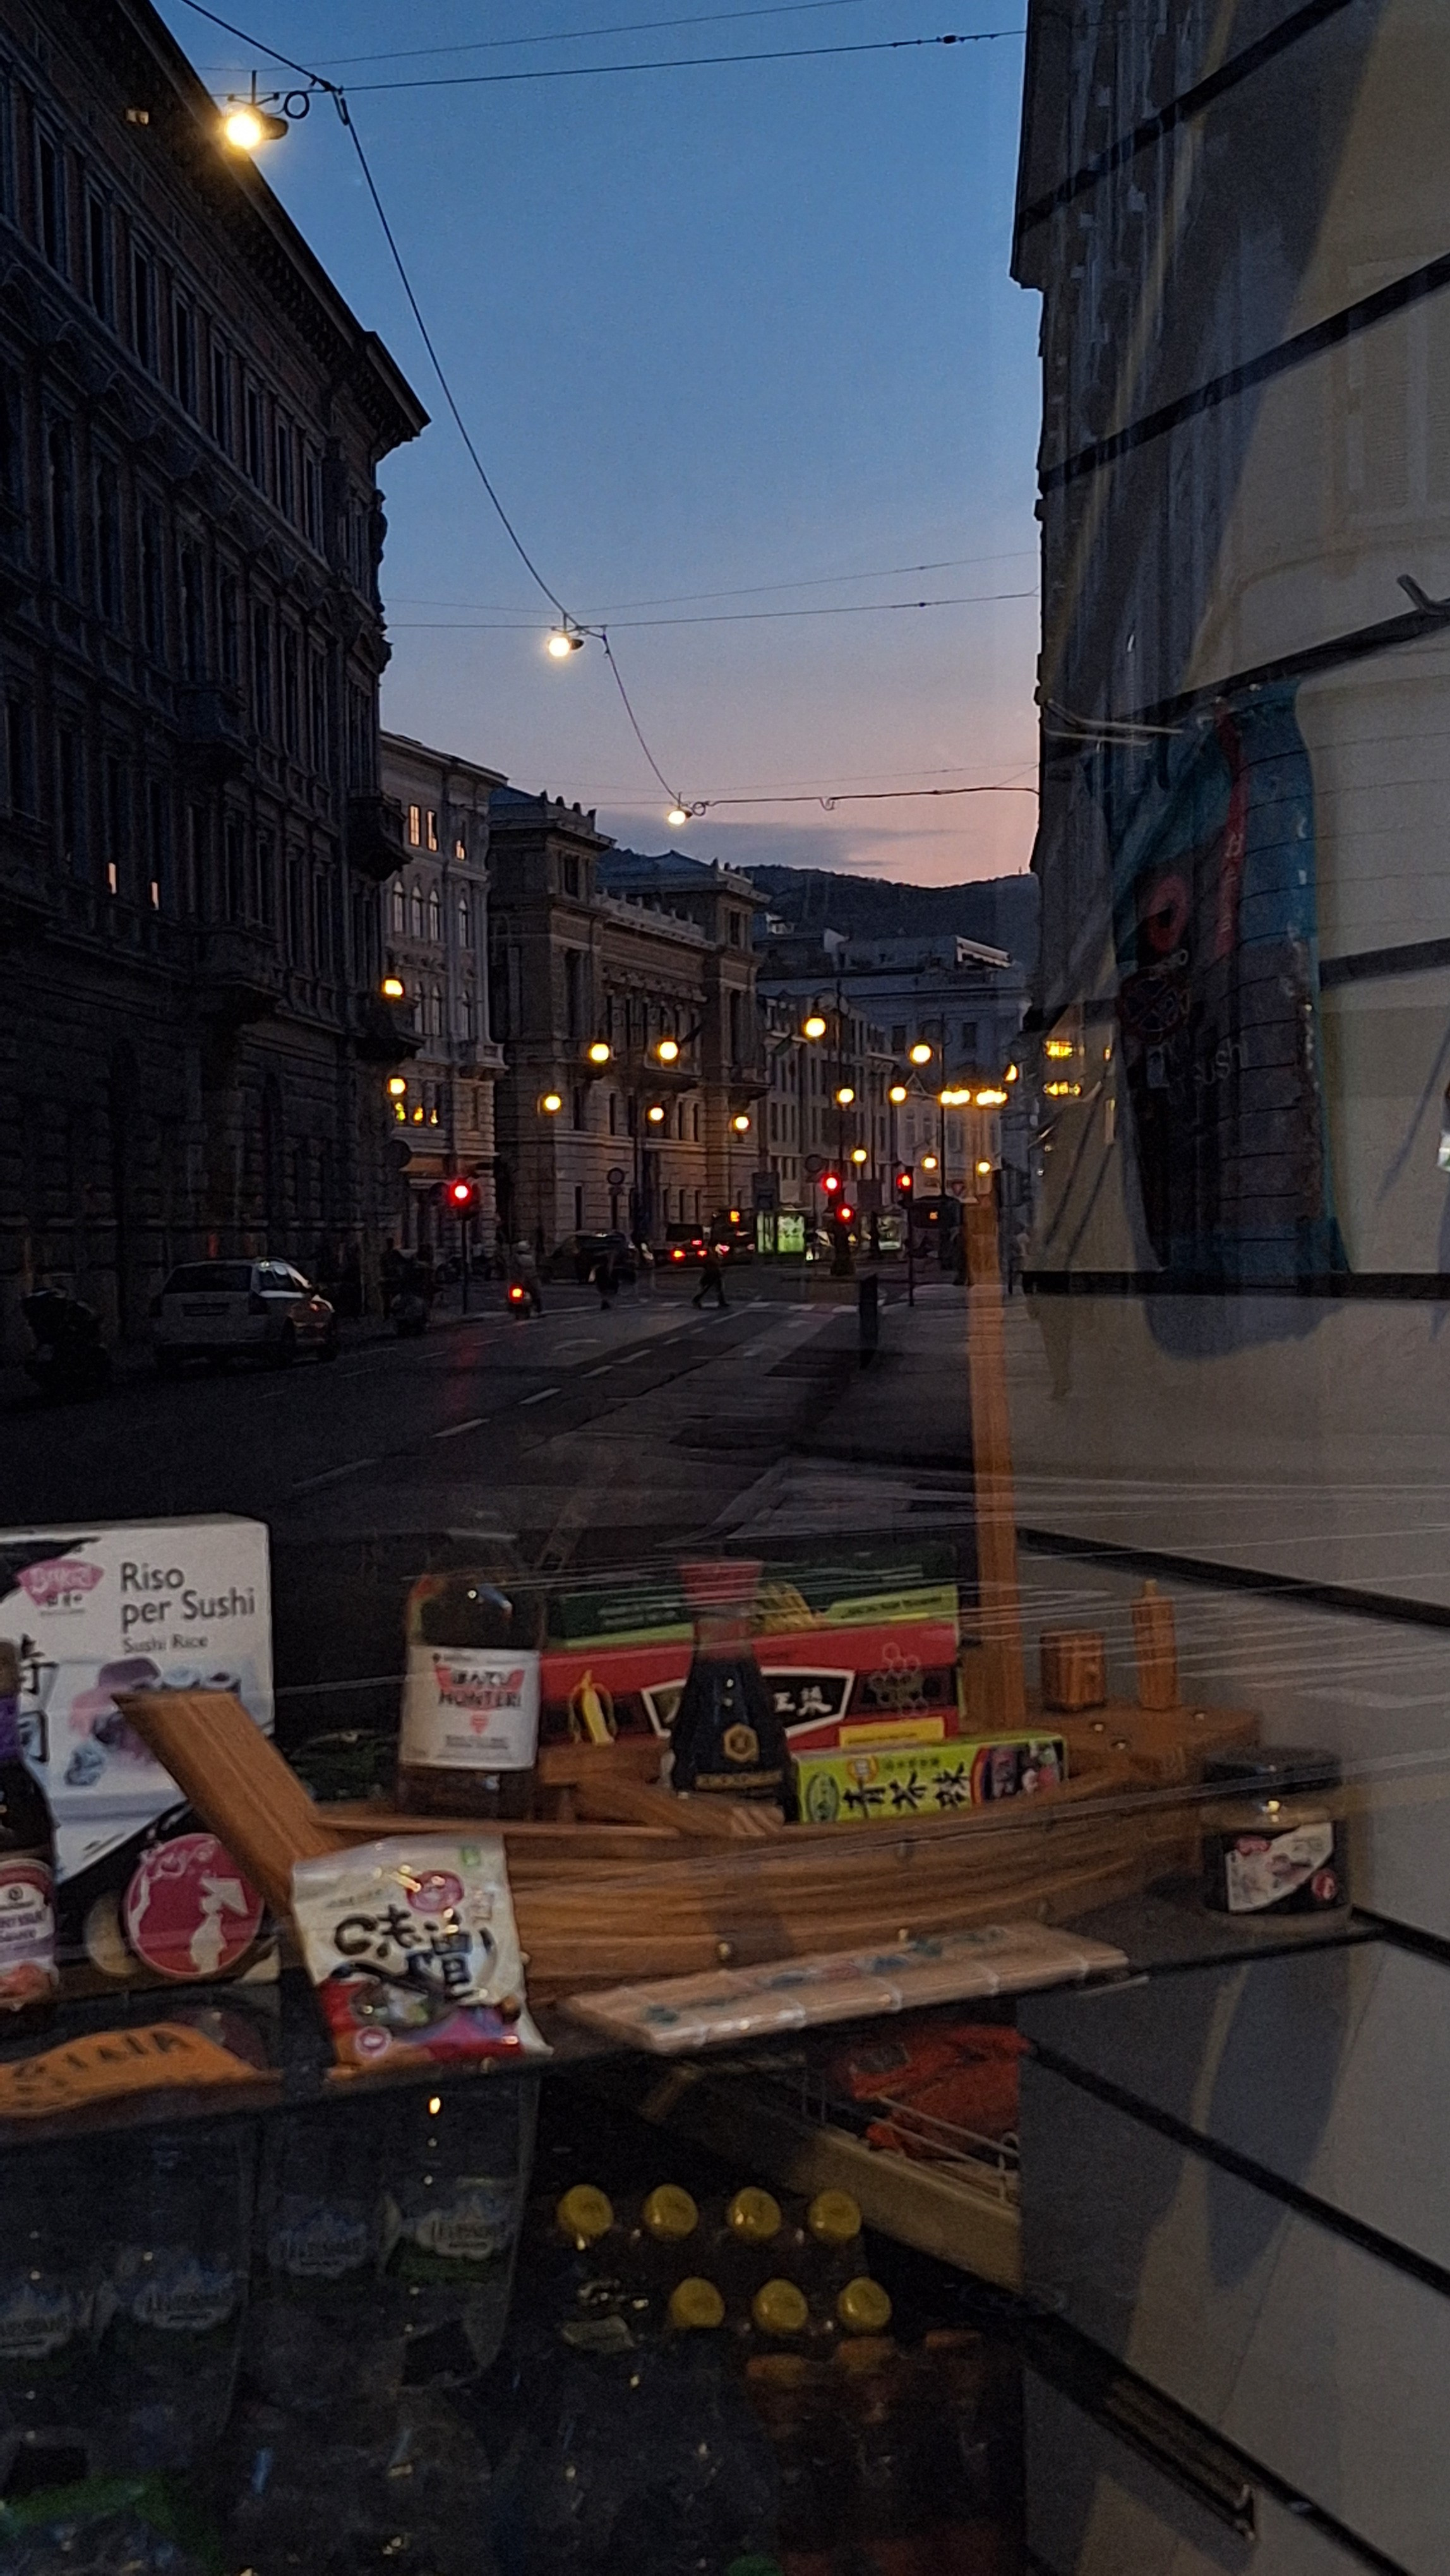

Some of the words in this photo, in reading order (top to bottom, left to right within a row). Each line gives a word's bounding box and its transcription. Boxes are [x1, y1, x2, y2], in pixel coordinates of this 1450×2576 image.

[121, 1561, 185, 1592] Riso
[122, 1601, 172, 1634] per
[182, 1587, 255, 1620] Sushi
[124, 1638, 167, 1654] Sushi
[172, 1634, 208, 1650] Rice
